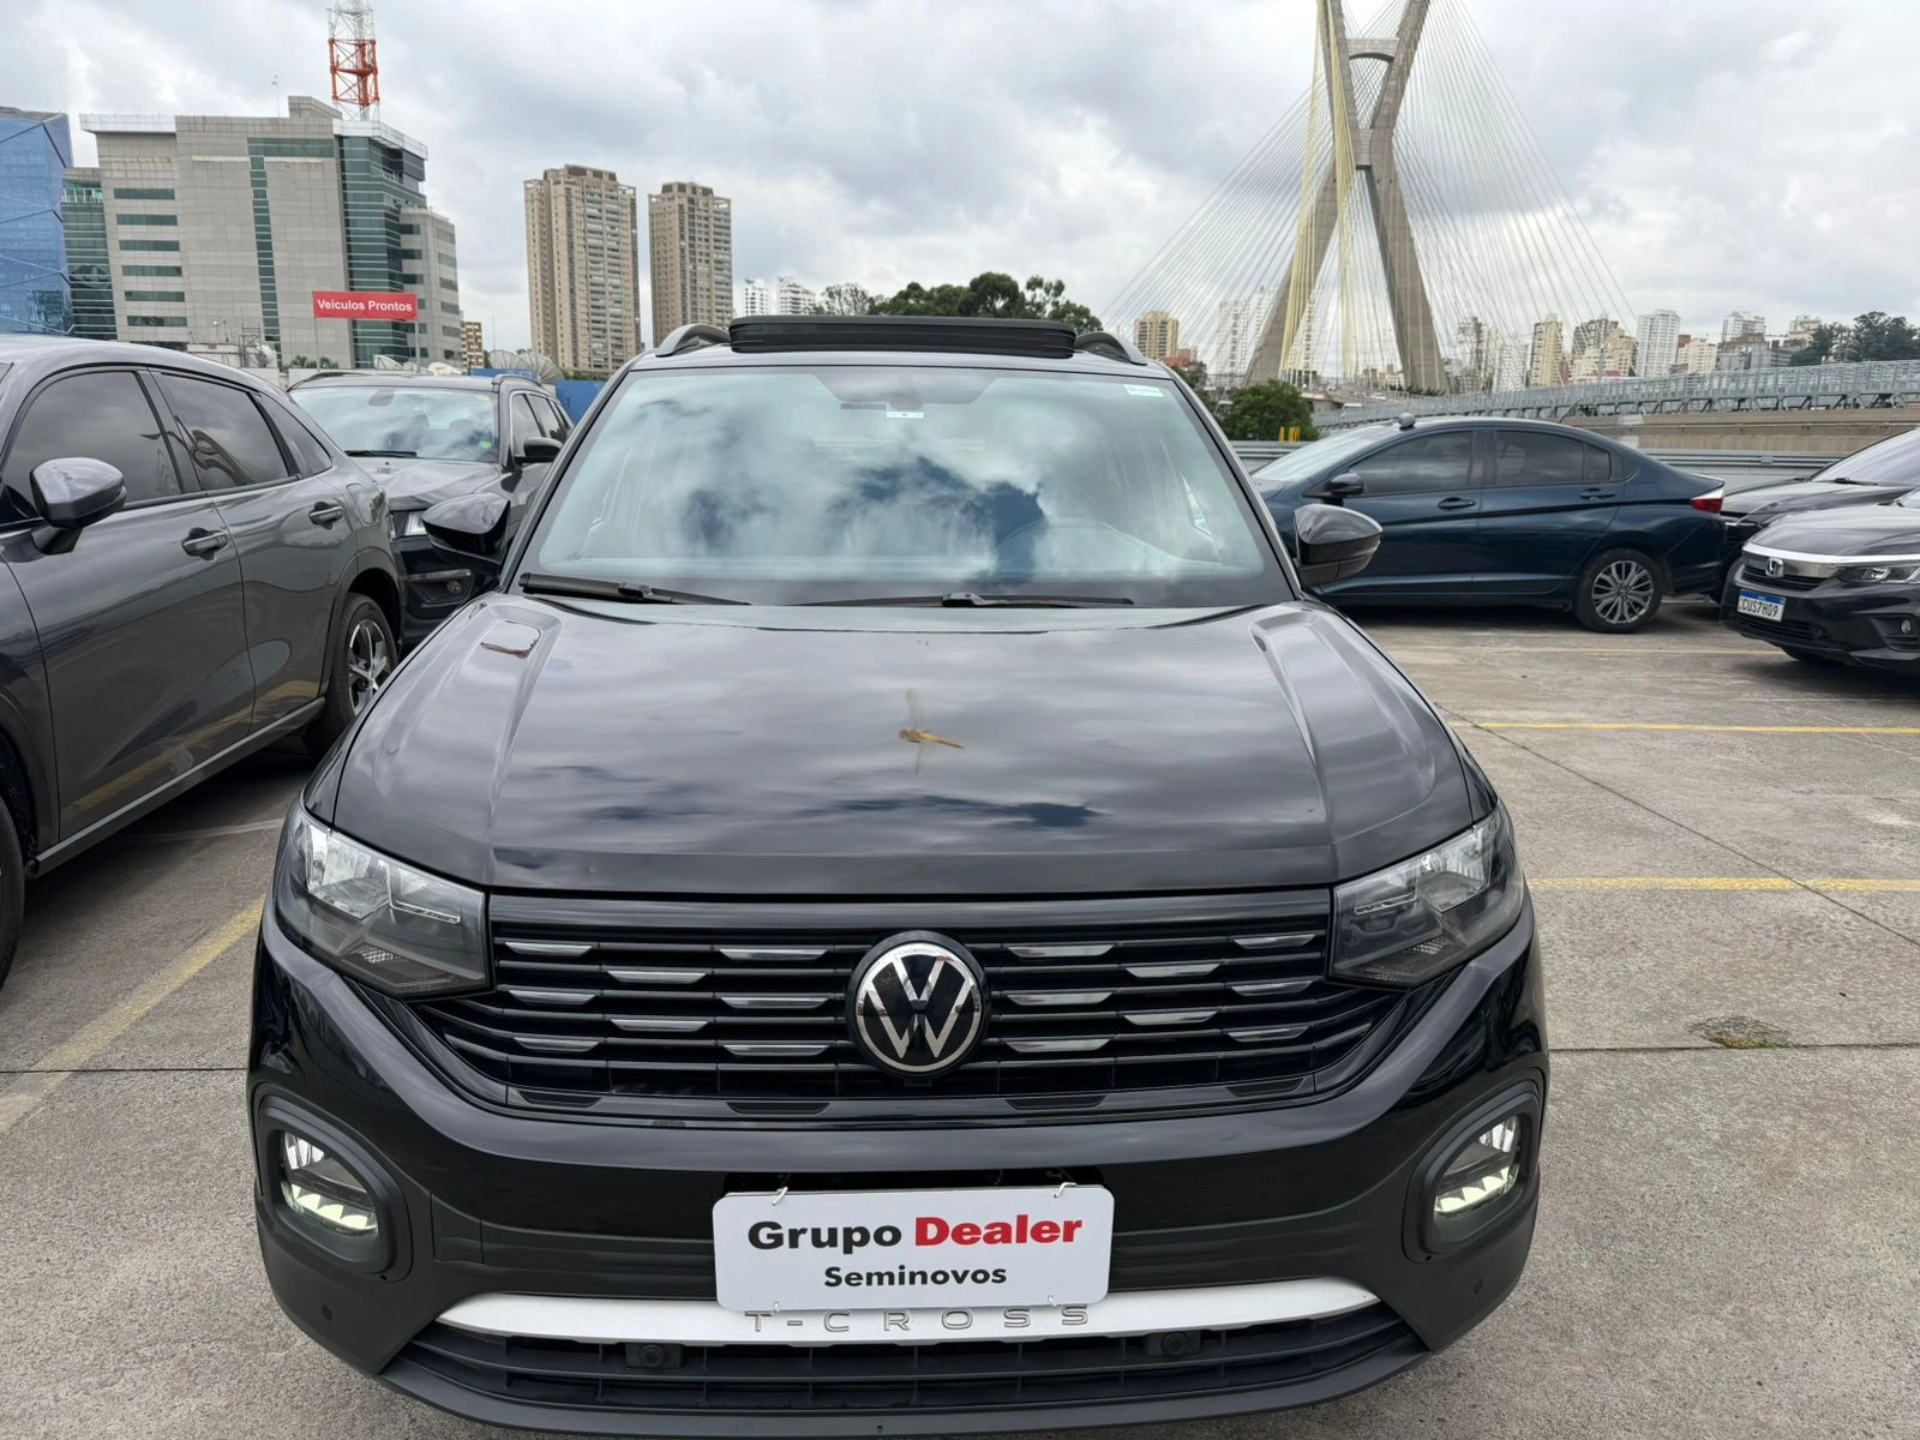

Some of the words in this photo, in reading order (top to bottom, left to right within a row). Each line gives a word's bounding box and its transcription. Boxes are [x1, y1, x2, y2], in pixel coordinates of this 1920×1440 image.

[368, 300, 412, 312] Prontos
[748, 1220, 902, 1254] Grupo
[914, 1214, 1082, 1246] Dealer
[823, 1264, 1007, 1288] Seminovos
[744, 1304, 1089, 1333] T-CROSS
